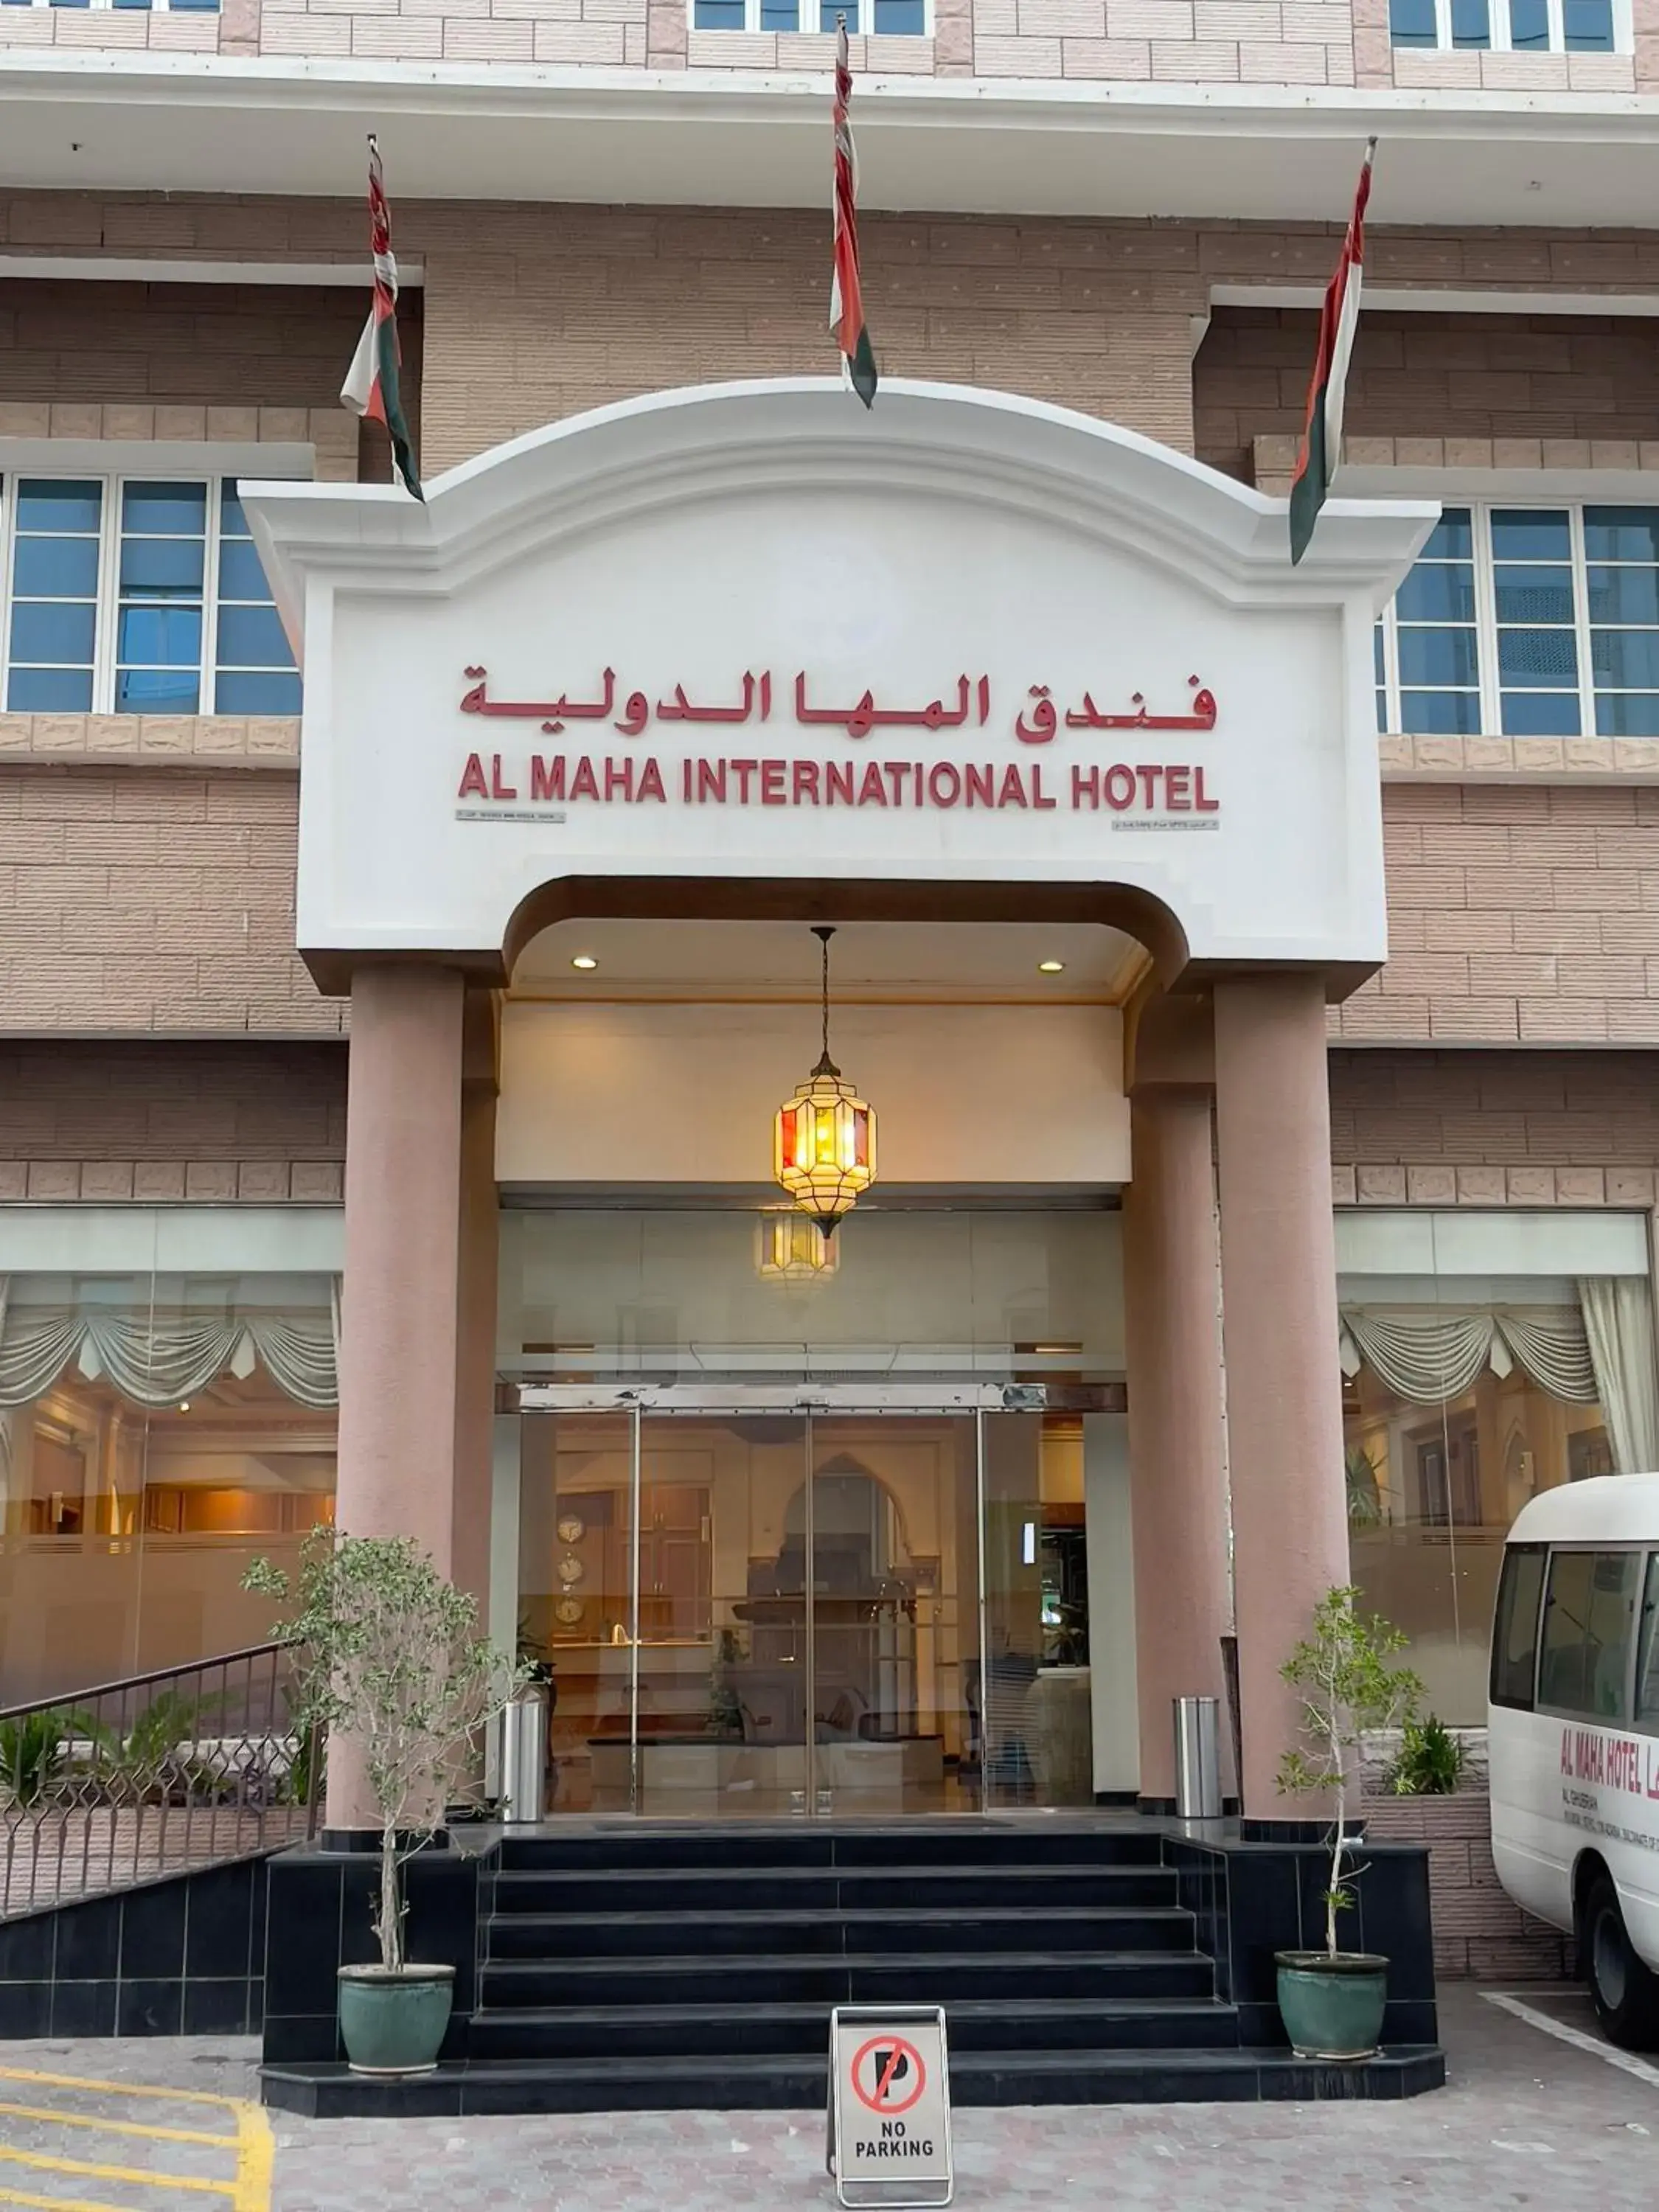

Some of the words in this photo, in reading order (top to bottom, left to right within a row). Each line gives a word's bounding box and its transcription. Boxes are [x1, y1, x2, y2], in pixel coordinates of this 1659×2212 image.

[459, 666, 771, 735] الدولية
[796, 669, 990, 738] المها
[1015, 674, 1217, 743] فندق
[458, 753, 518, 799] AL
[531, 755, 667, 802] MAHA
[684, 758, 1056, 808] INTERNATIONAL
[1072, 764, 1219, 810] HOTEL
[1561, 1728, 1573, 1775] AL
[1576, 1731, 1604, 1784] MAHA
[1606, 1737, 1641, 1794] HOTEL
[874, 2051, 908, 2098] P
[856, 2140, 933, 2157] PARKING
[881, 2121, 905, 2138] NO
